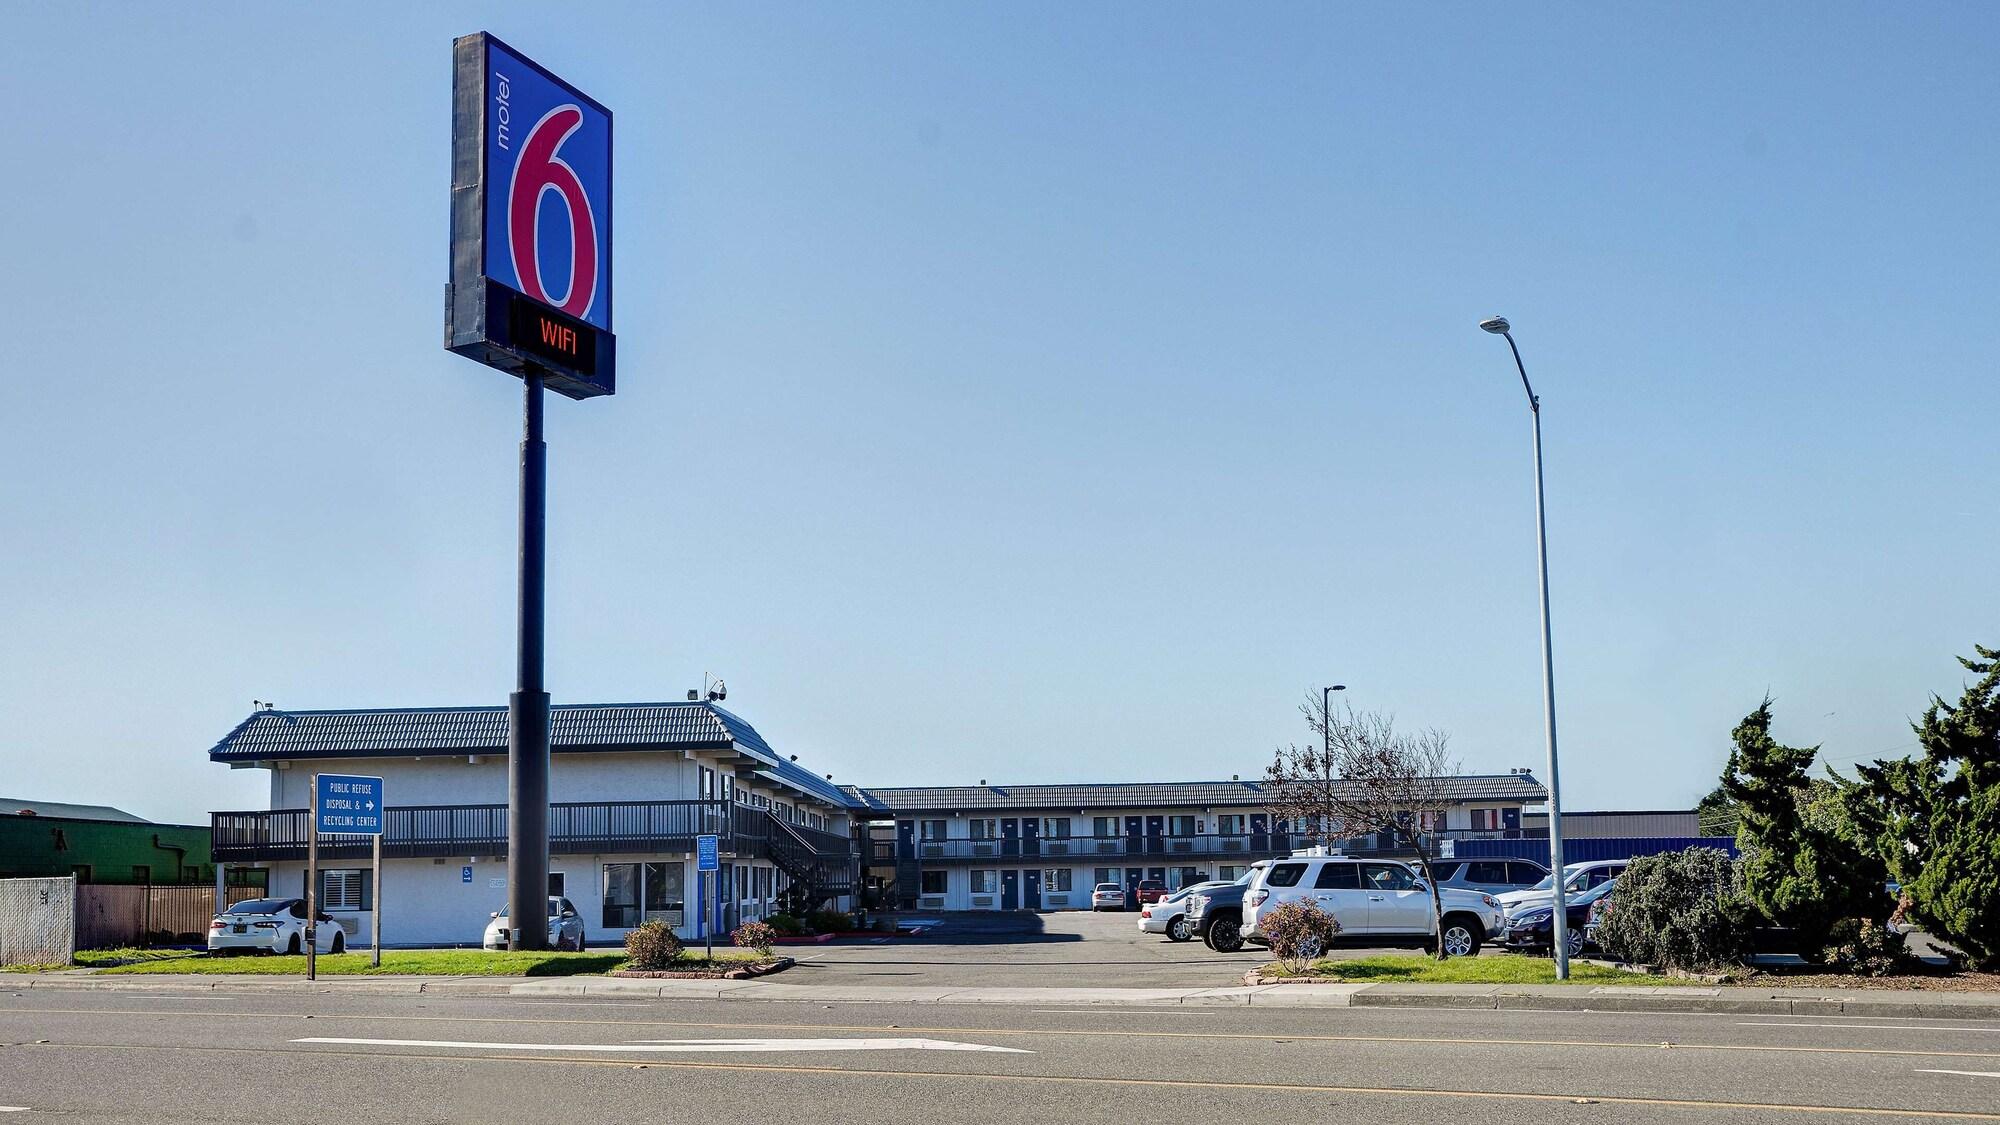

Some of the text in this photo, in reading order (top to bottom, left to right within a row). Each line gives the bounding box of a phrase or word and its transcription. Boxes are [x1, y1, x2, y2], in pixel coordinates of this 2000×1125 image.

[495, 71, 511, 151] motel
[508, 104, 598, 320] 6
[540, 317, 576, 355] WIFI
[330, 783, 372, 794] PUBLIC REFUSE
[326, 800, 360, 810] DISPOSAL &
[323, 816, 376, 826] RECYCLING CENTER
